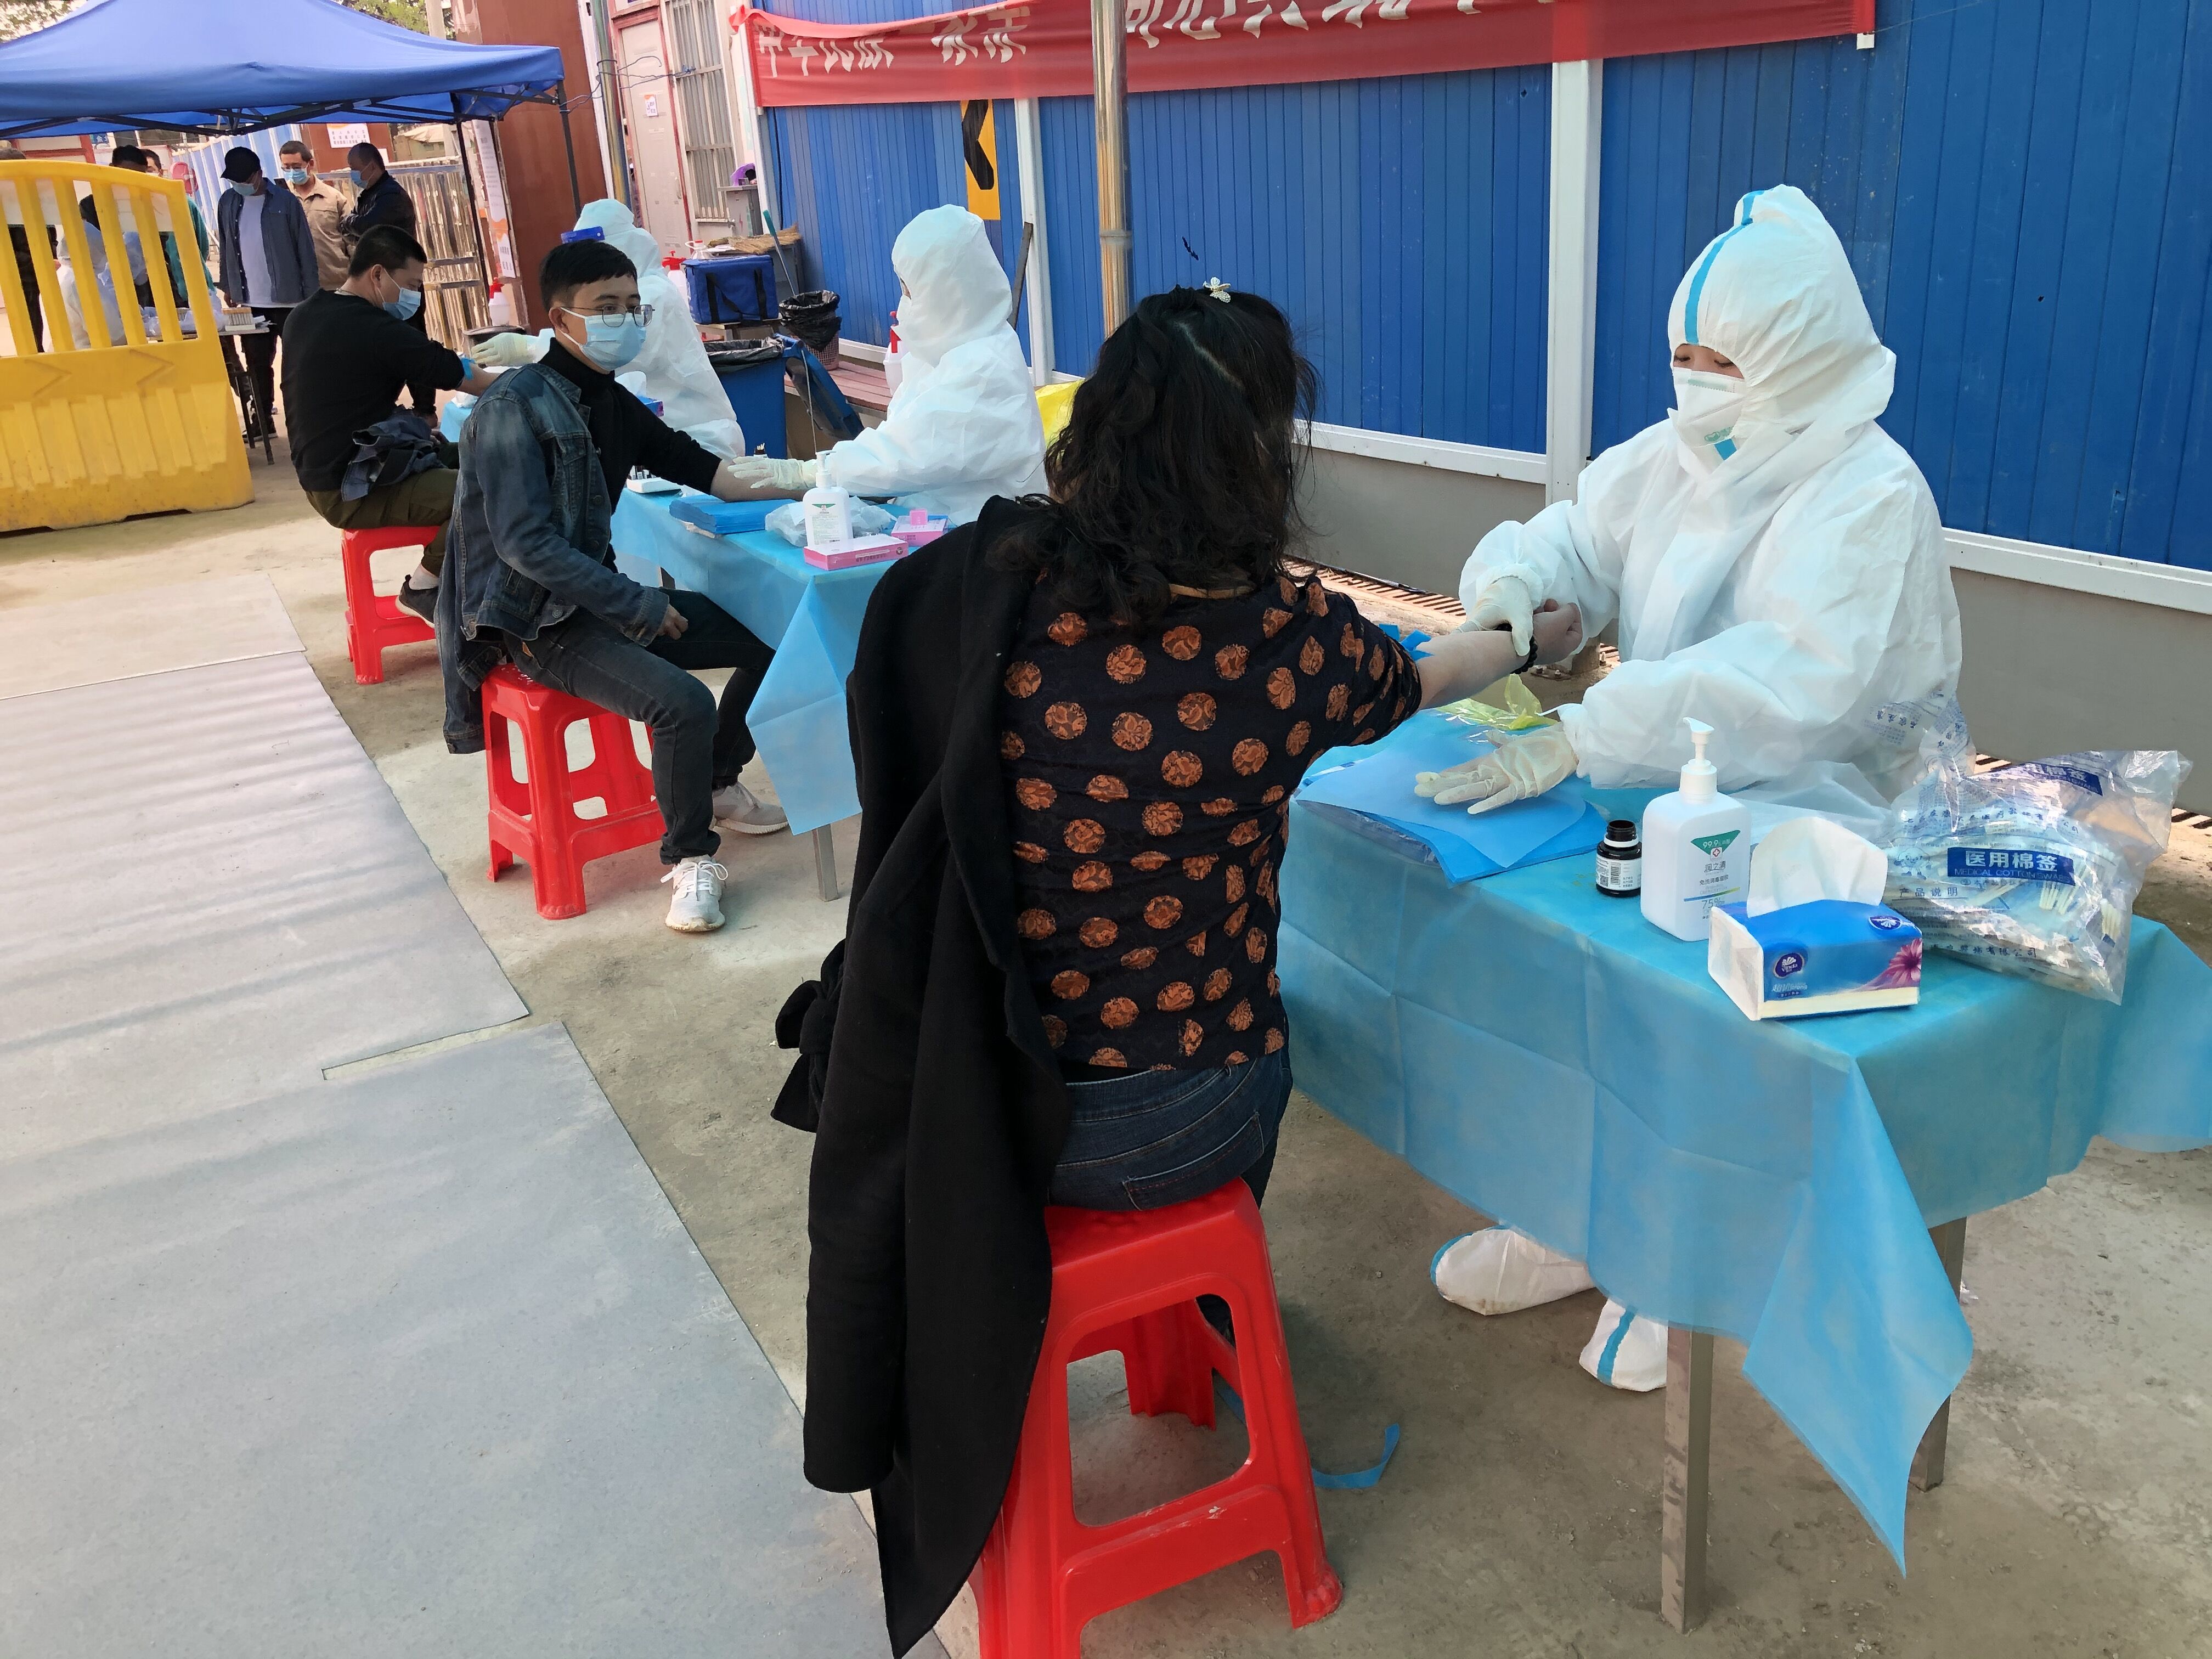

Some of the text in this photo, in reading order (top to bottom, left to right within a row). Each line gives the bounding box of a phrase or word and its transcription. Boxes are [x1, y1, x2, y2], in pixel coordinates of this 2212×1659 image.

[1965, 850, 2058, 872] 医用棉签
[1996, 869, 2035, 878] COTTON
[1899, 887, 1958, 898] 产品说明
